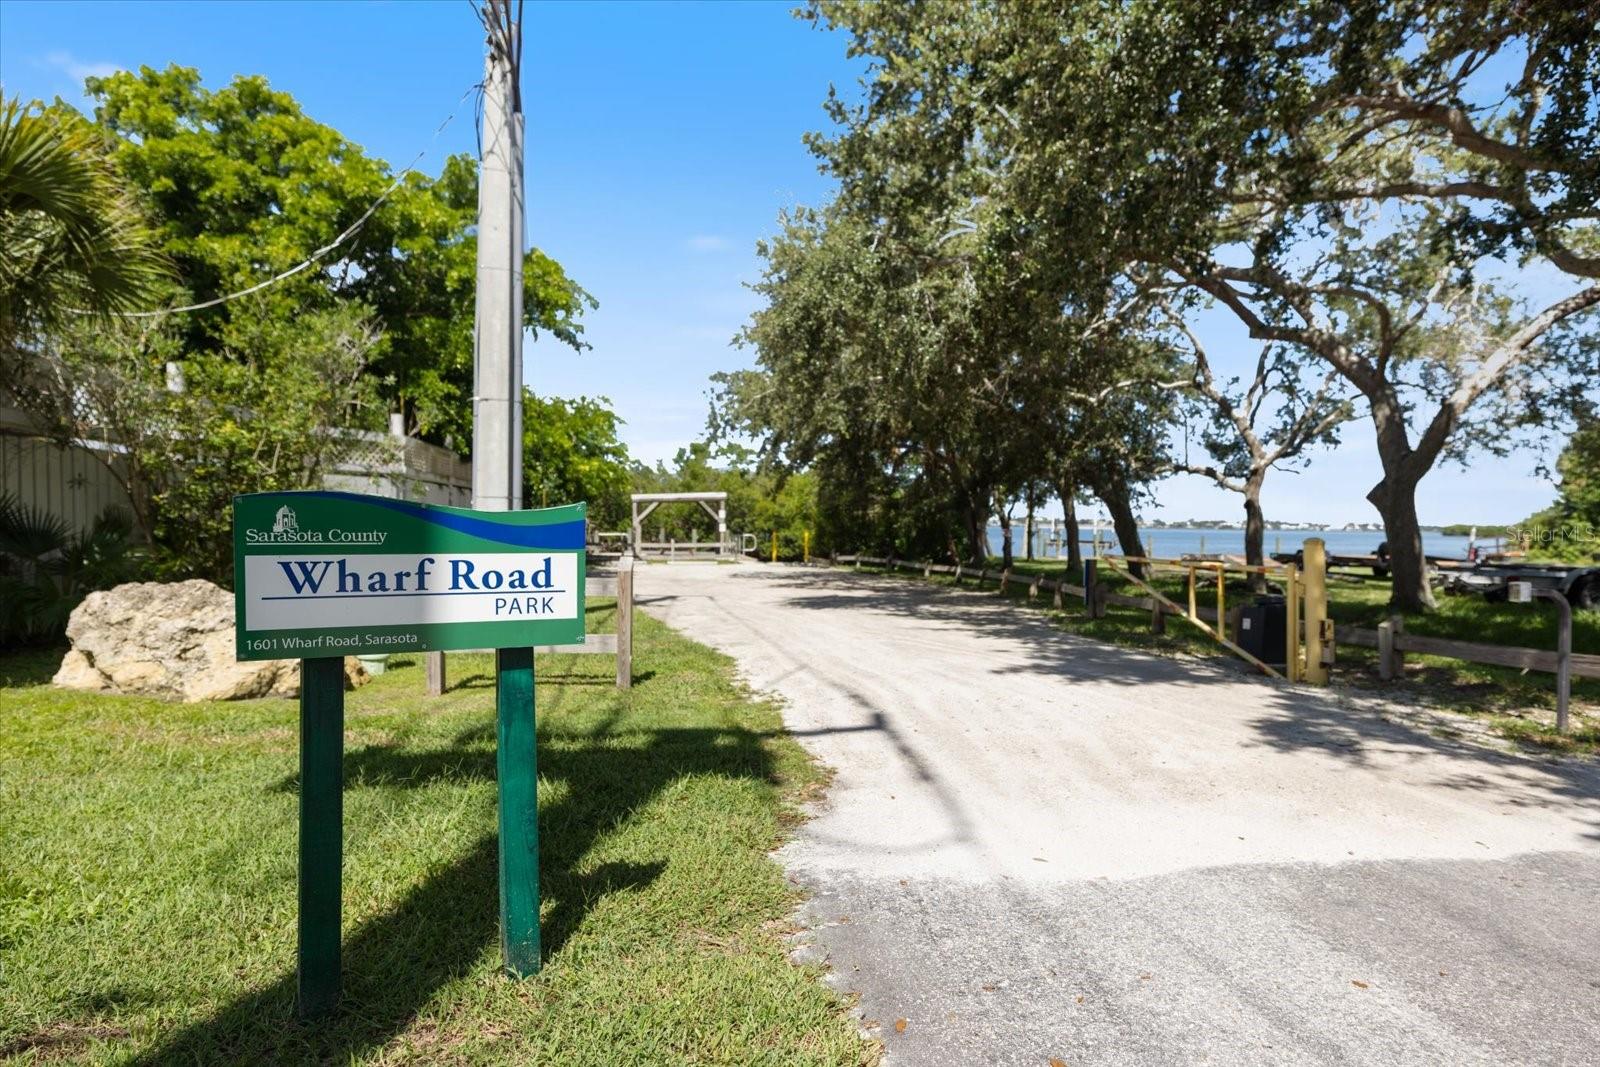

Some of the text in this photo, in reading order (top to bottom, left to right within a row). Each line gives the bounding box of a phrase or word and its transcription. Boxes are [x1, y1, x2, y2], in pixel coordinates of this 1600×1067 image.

[246, 528, 388, 545] Sarasota County
[277, 556, 554, 594] Wharf Road
[495, 597, 555, 616] PARK
[246, 633, 418, 651] 1601 Wharf Road, Sarasota
